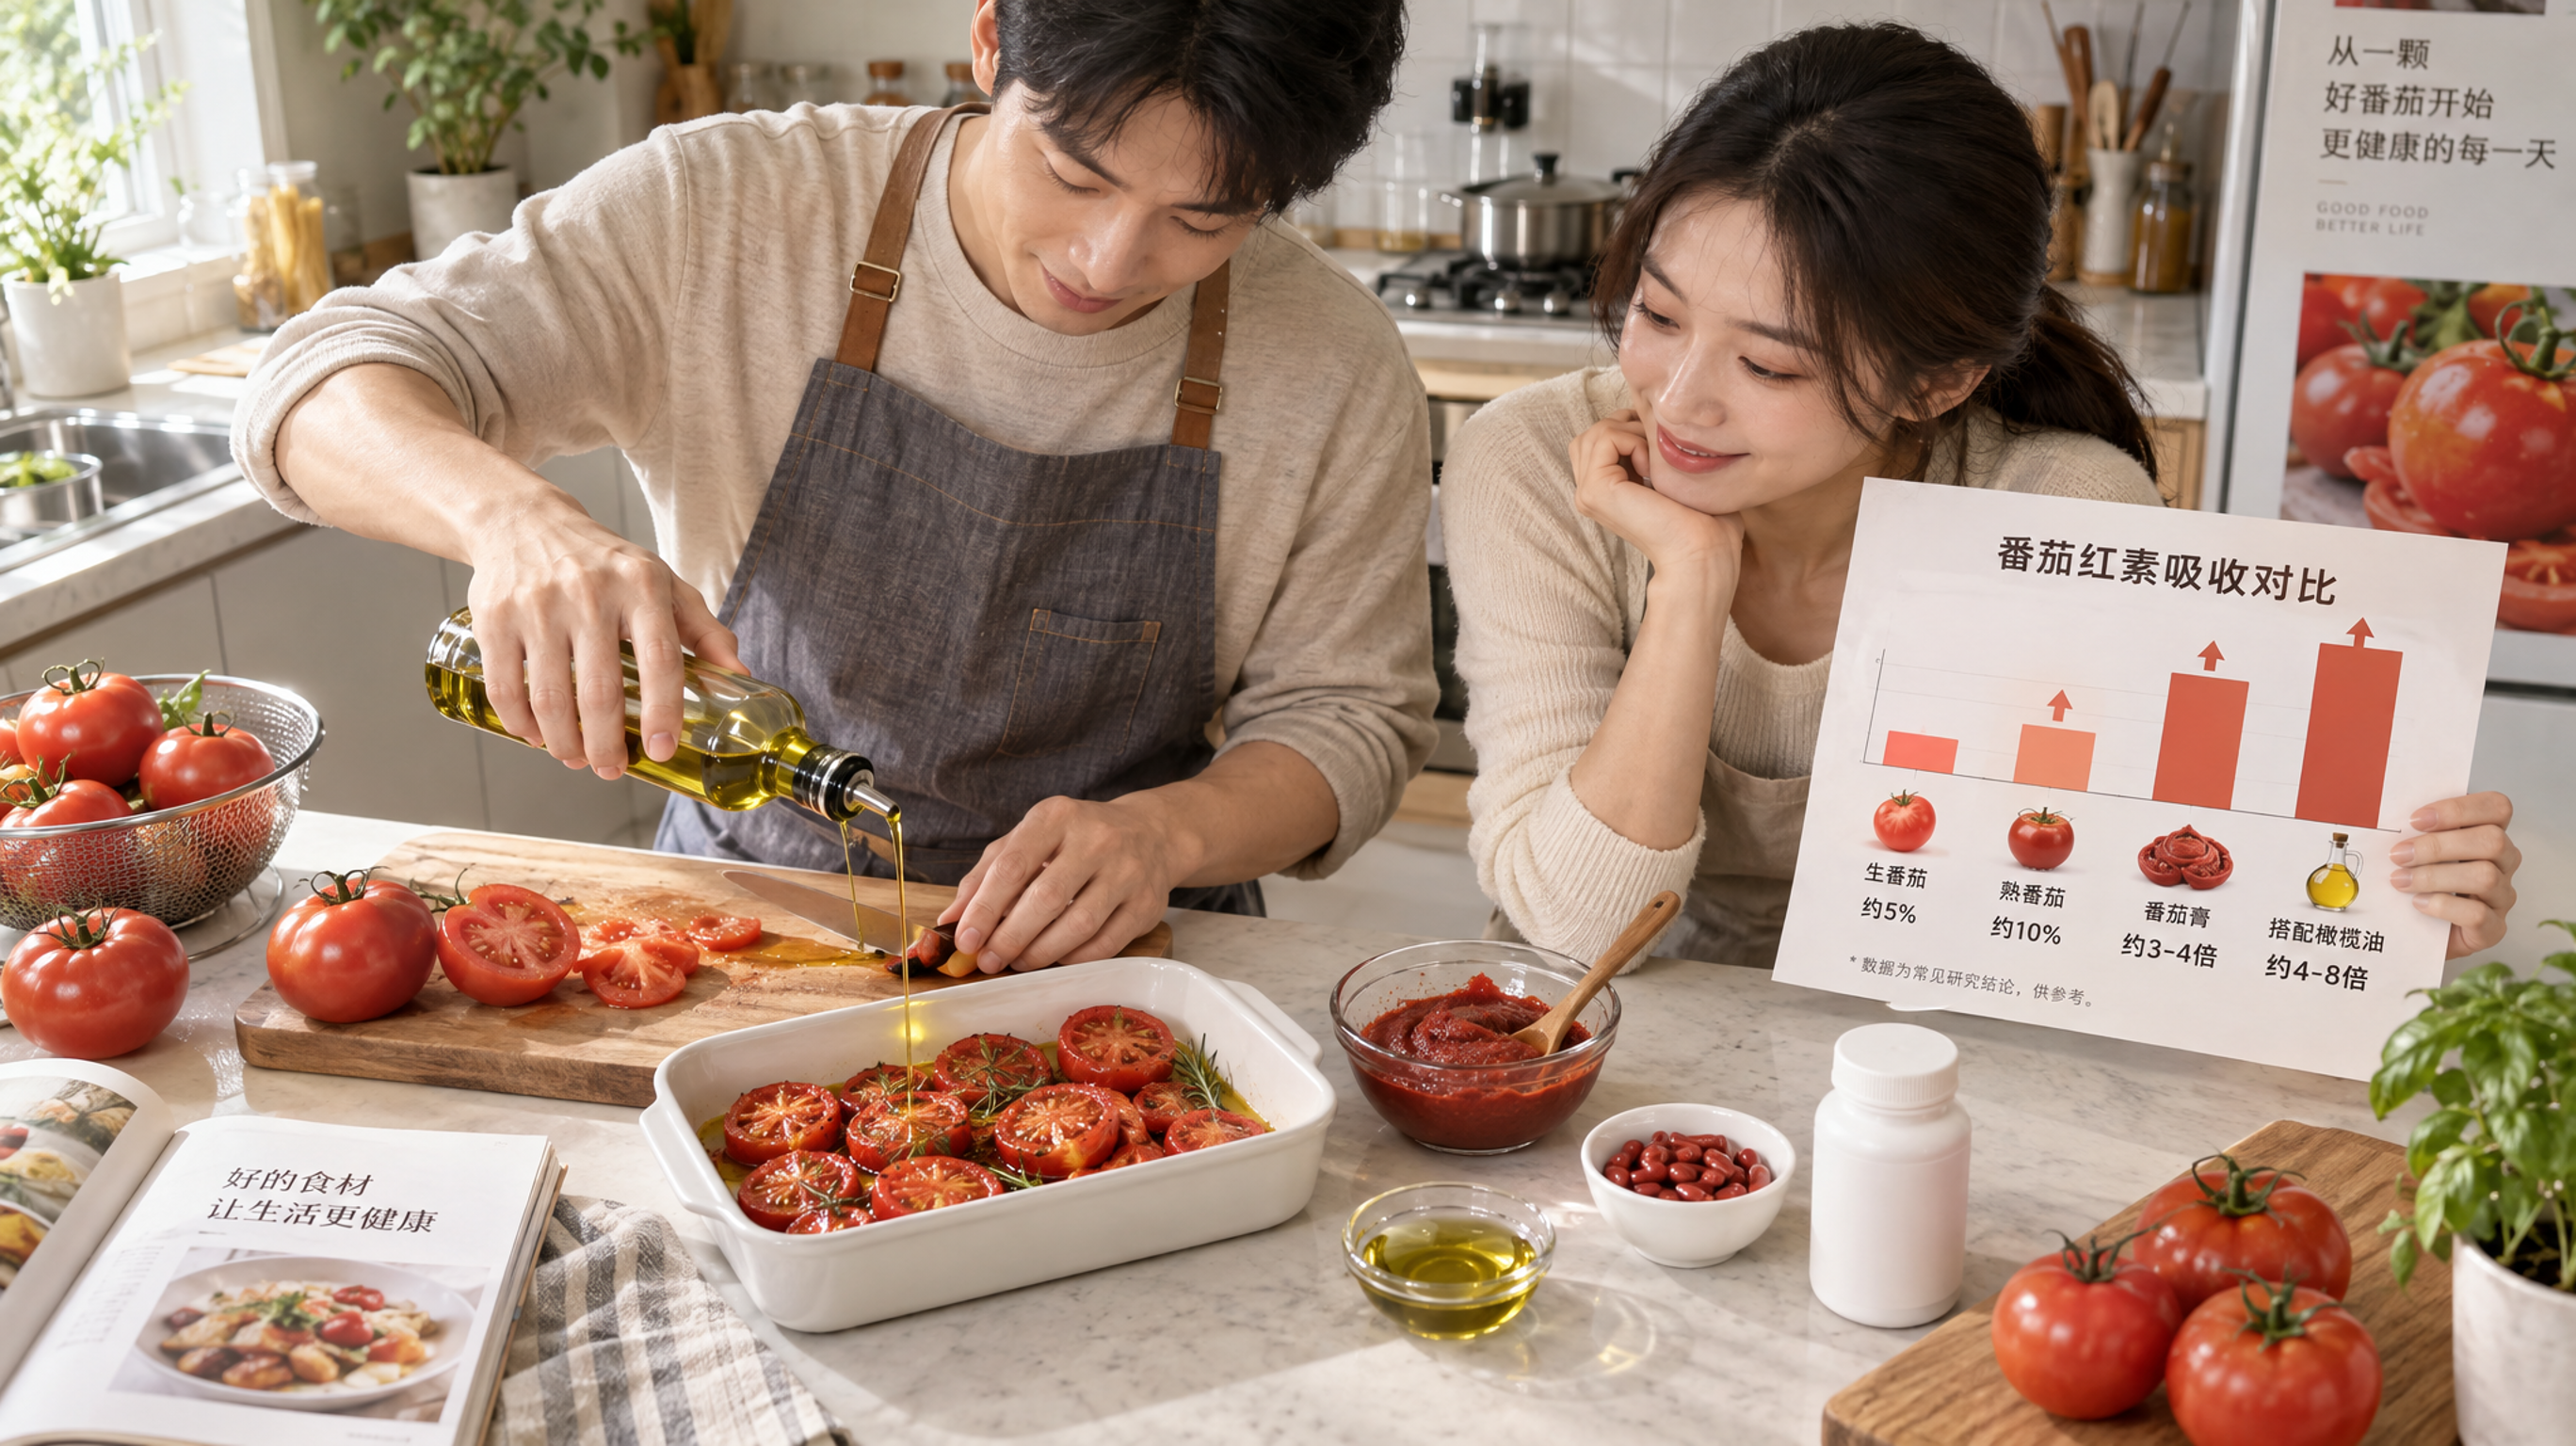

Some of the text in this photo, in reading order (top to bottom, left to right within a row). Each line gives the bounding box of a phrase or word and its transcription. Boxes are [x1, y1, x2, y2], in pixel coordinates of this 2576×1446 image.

[2327, 35, 2431, 70] 从一颗
[2324, 80, 2494, 120] 好番茄开始
[2320, 128, 2556, 169] 更健康的每一天
[2317, 201, 2429, 219] GOOD FOOD
[2315, 218, 2425, 236] BETTER LIFE
[1998, 536, 2337, 605] 番茄红素吸收对比
[1864, 862, 1927, 889] 生番茄
[1999, 880, 2066, 908] 熟番茄
[1860, 896, 1917, 924] 约5%
[1990, 915, 2061, 945] 约10%
[2268, 918, 2385, 953] 搭配橄榄油
[222, 1167, 374, 1196] 好的食材
[207, 1197, 439, 1232] 让生活更健康
